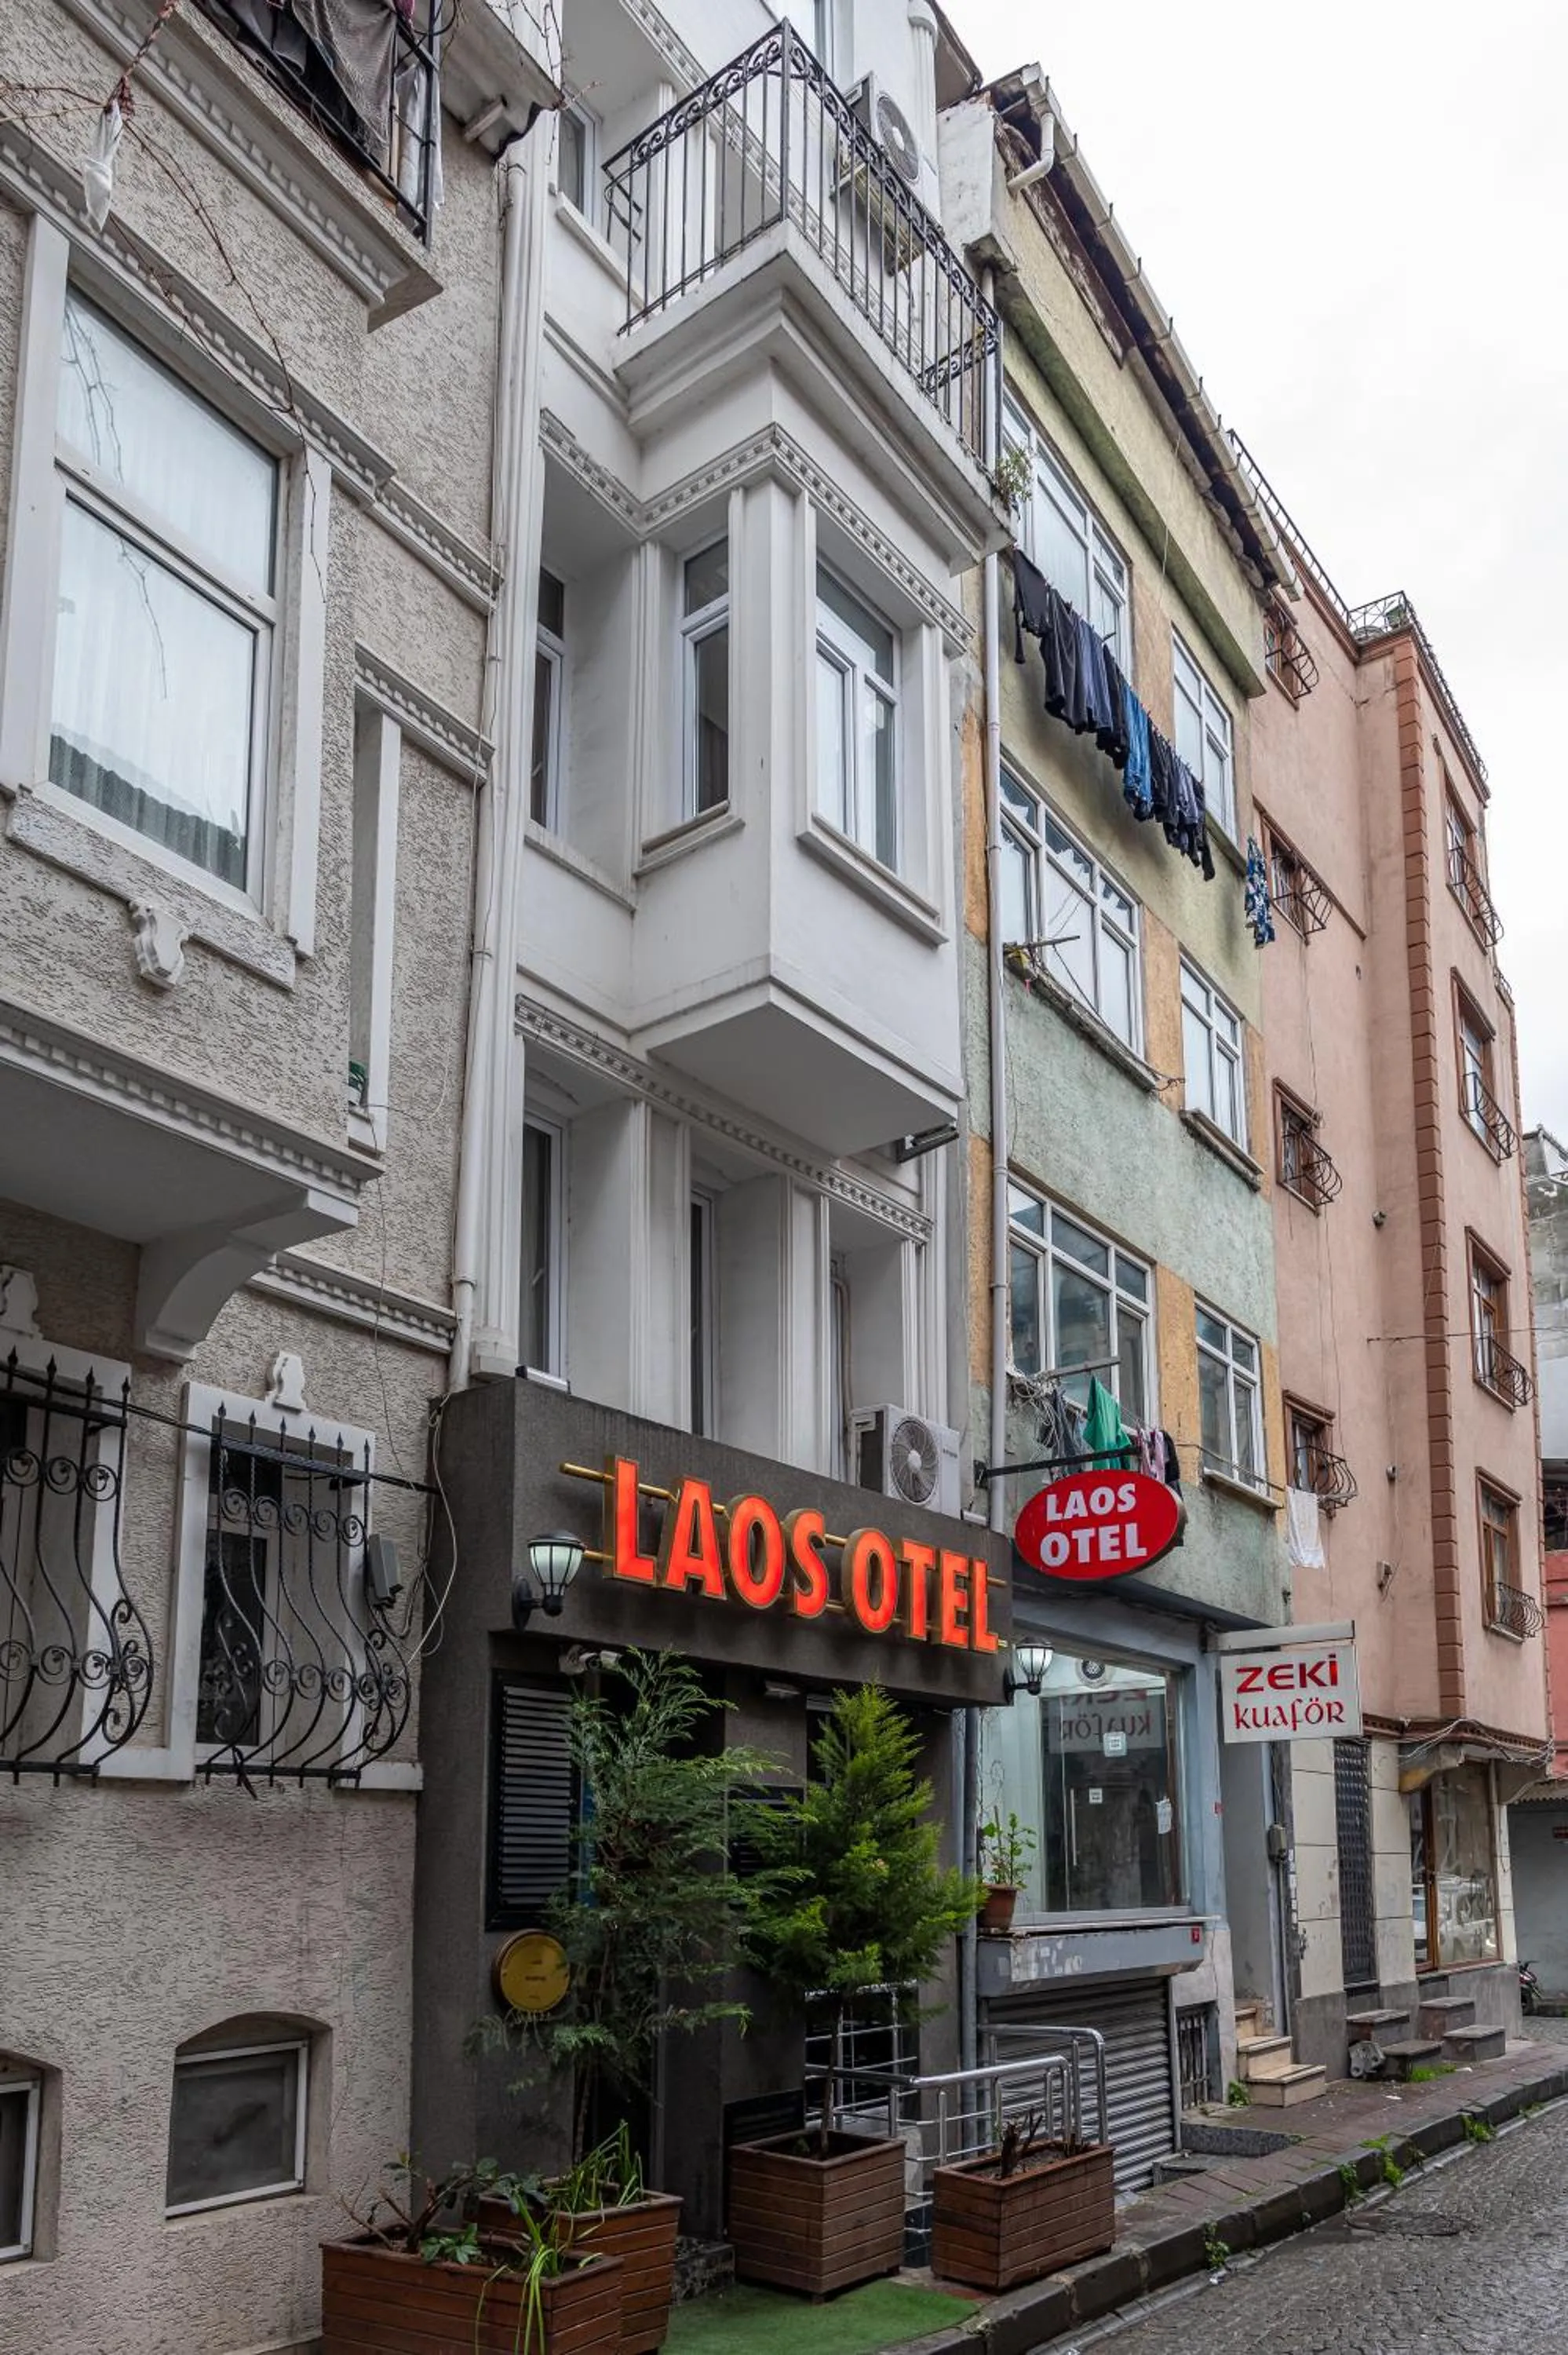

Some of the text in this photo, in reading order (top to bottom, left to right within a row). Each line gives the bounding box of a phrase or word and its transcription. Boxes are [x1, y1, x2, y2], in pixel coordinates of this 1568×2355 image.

[1046, 1483, 1136, 1522] LAOS
[604, 1455, 1000, 1655] LAOS OTEL
[1040, 1522, 1147, 1568] OTEL
[1235, 1653, 1338, 1694] ZEKİ
